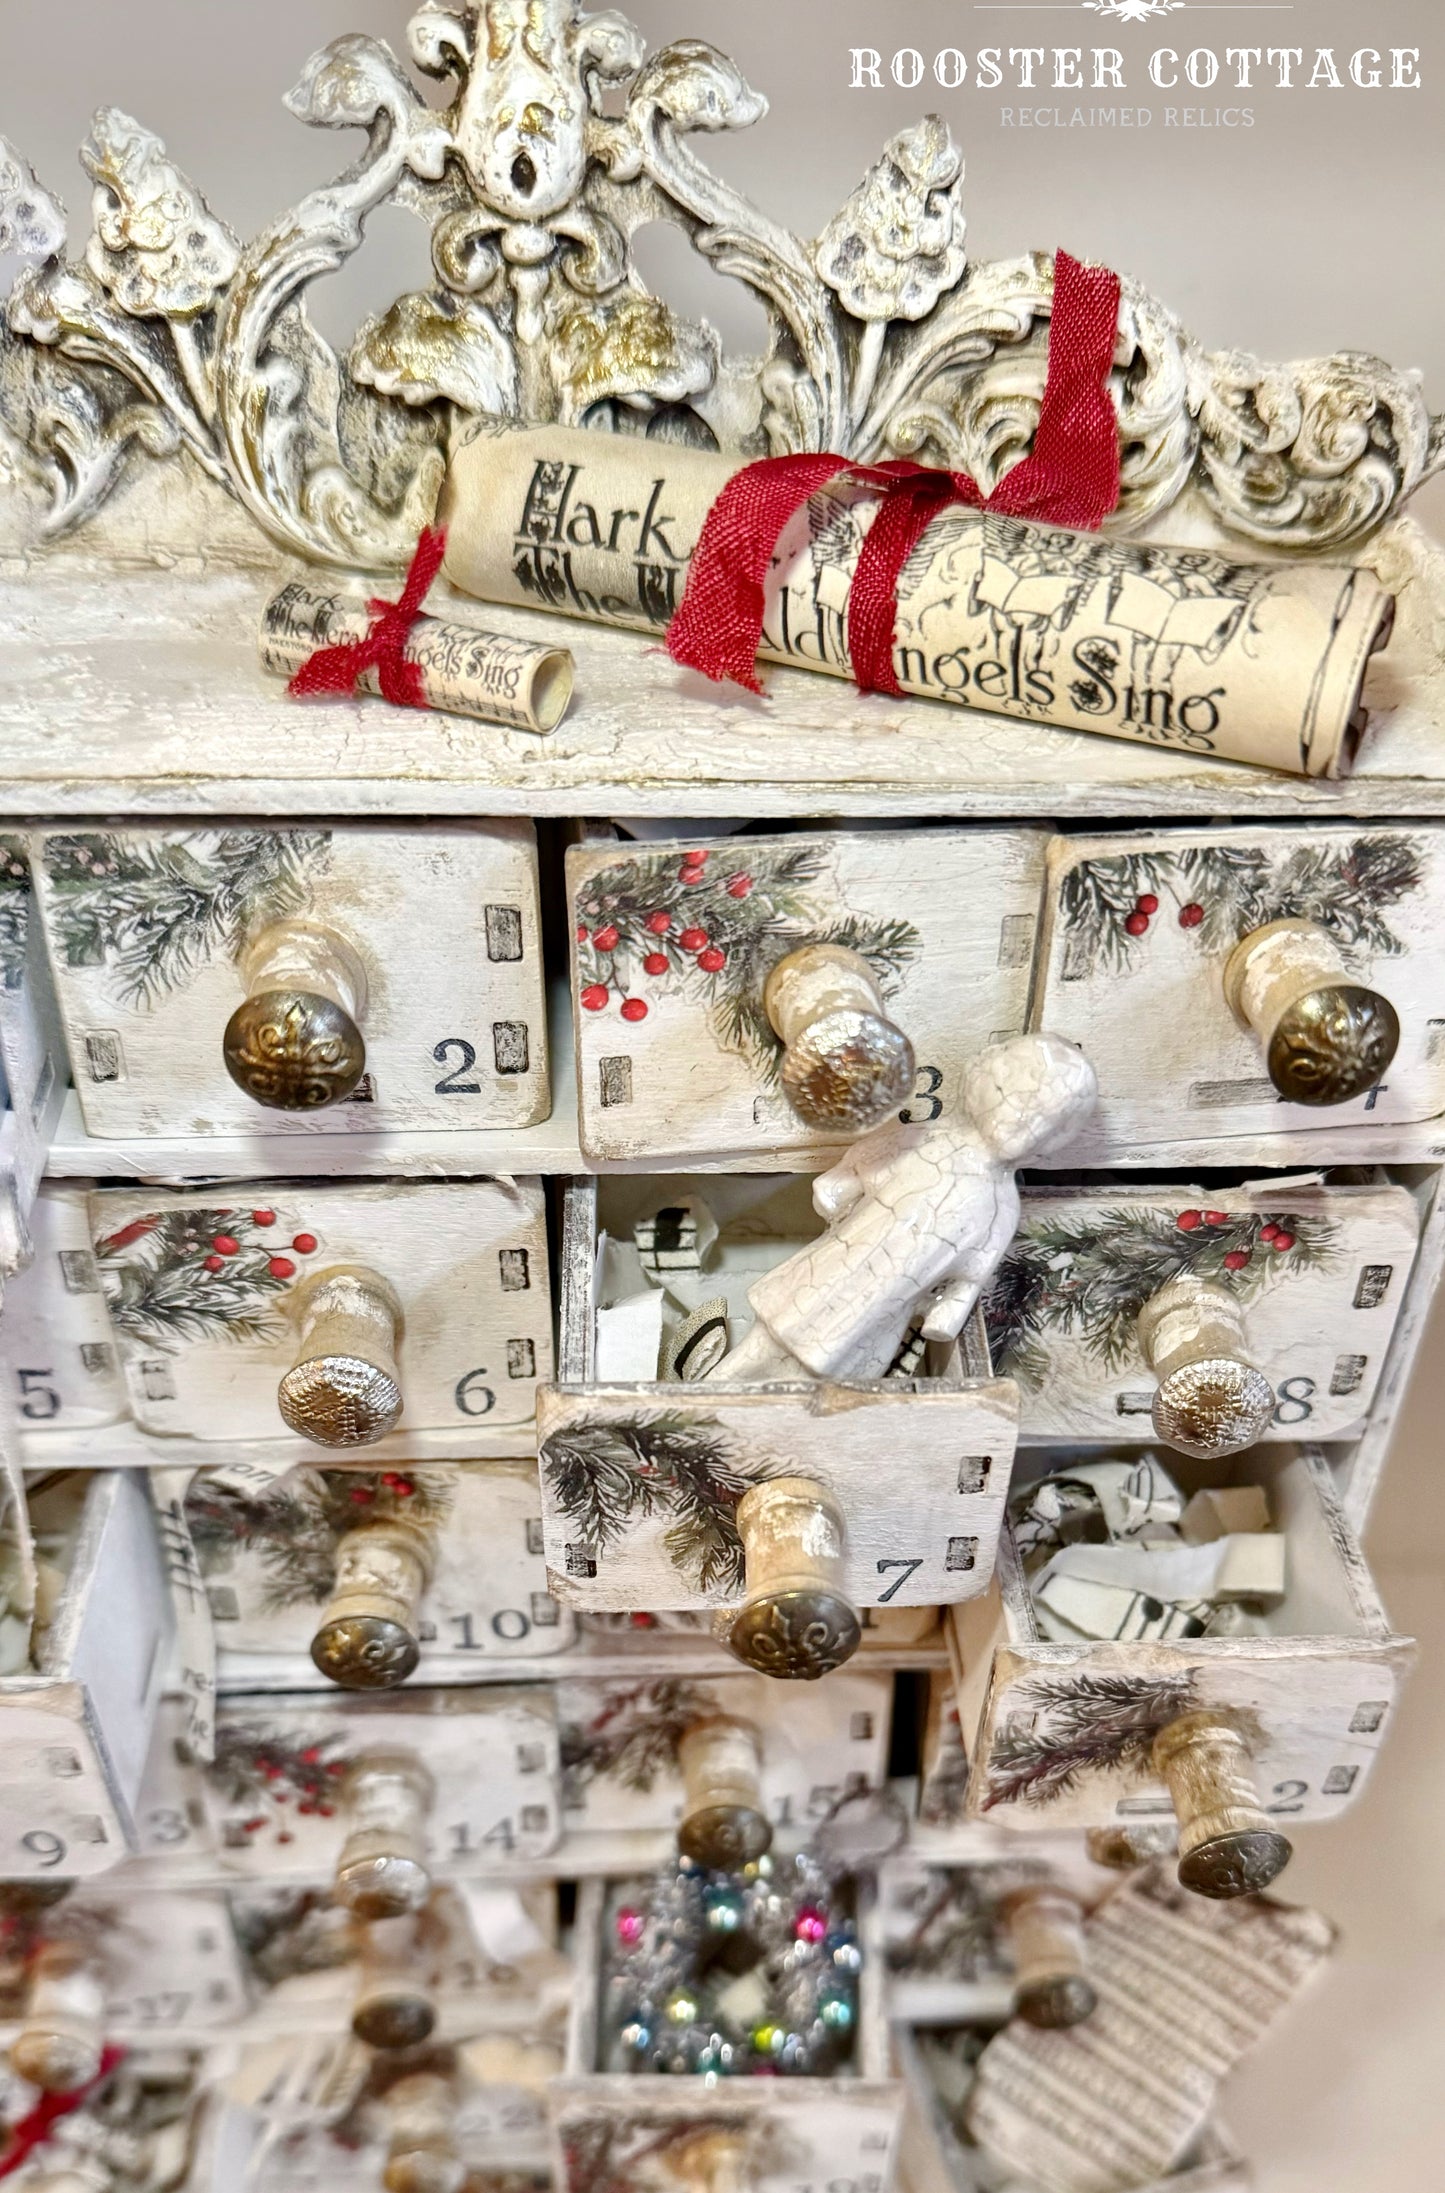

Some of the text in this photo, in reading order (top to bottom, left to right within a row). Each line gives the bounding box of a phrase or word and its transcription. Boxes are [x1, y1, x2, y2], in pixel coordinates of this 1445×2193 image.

[513, 459, 696, 562] Hark
[405, 640, 463, 680] ngels
[466, 645, 524, 700] Sing
[512, 542, 635, 620] The
[897, 624, 1055, 708] ngels
[1067, 635, 1226, 750] Sing
[433, 1038, 482, 1095] 2
[898, 1065, 943, 1125] 3
[17, 1367, 61, 1420] 5
[455, 1368, 497, 1417] 6
[1272, 1376, 1317, 1425] 8
[877, 1558, 924, 1602] 7
[450, 1609, 531, 1650] 10
[1264, 1779, 1309, 1814] 2
[21, 1830, 67, 1867] 9
[448, 1816, 516, 1854] 14
